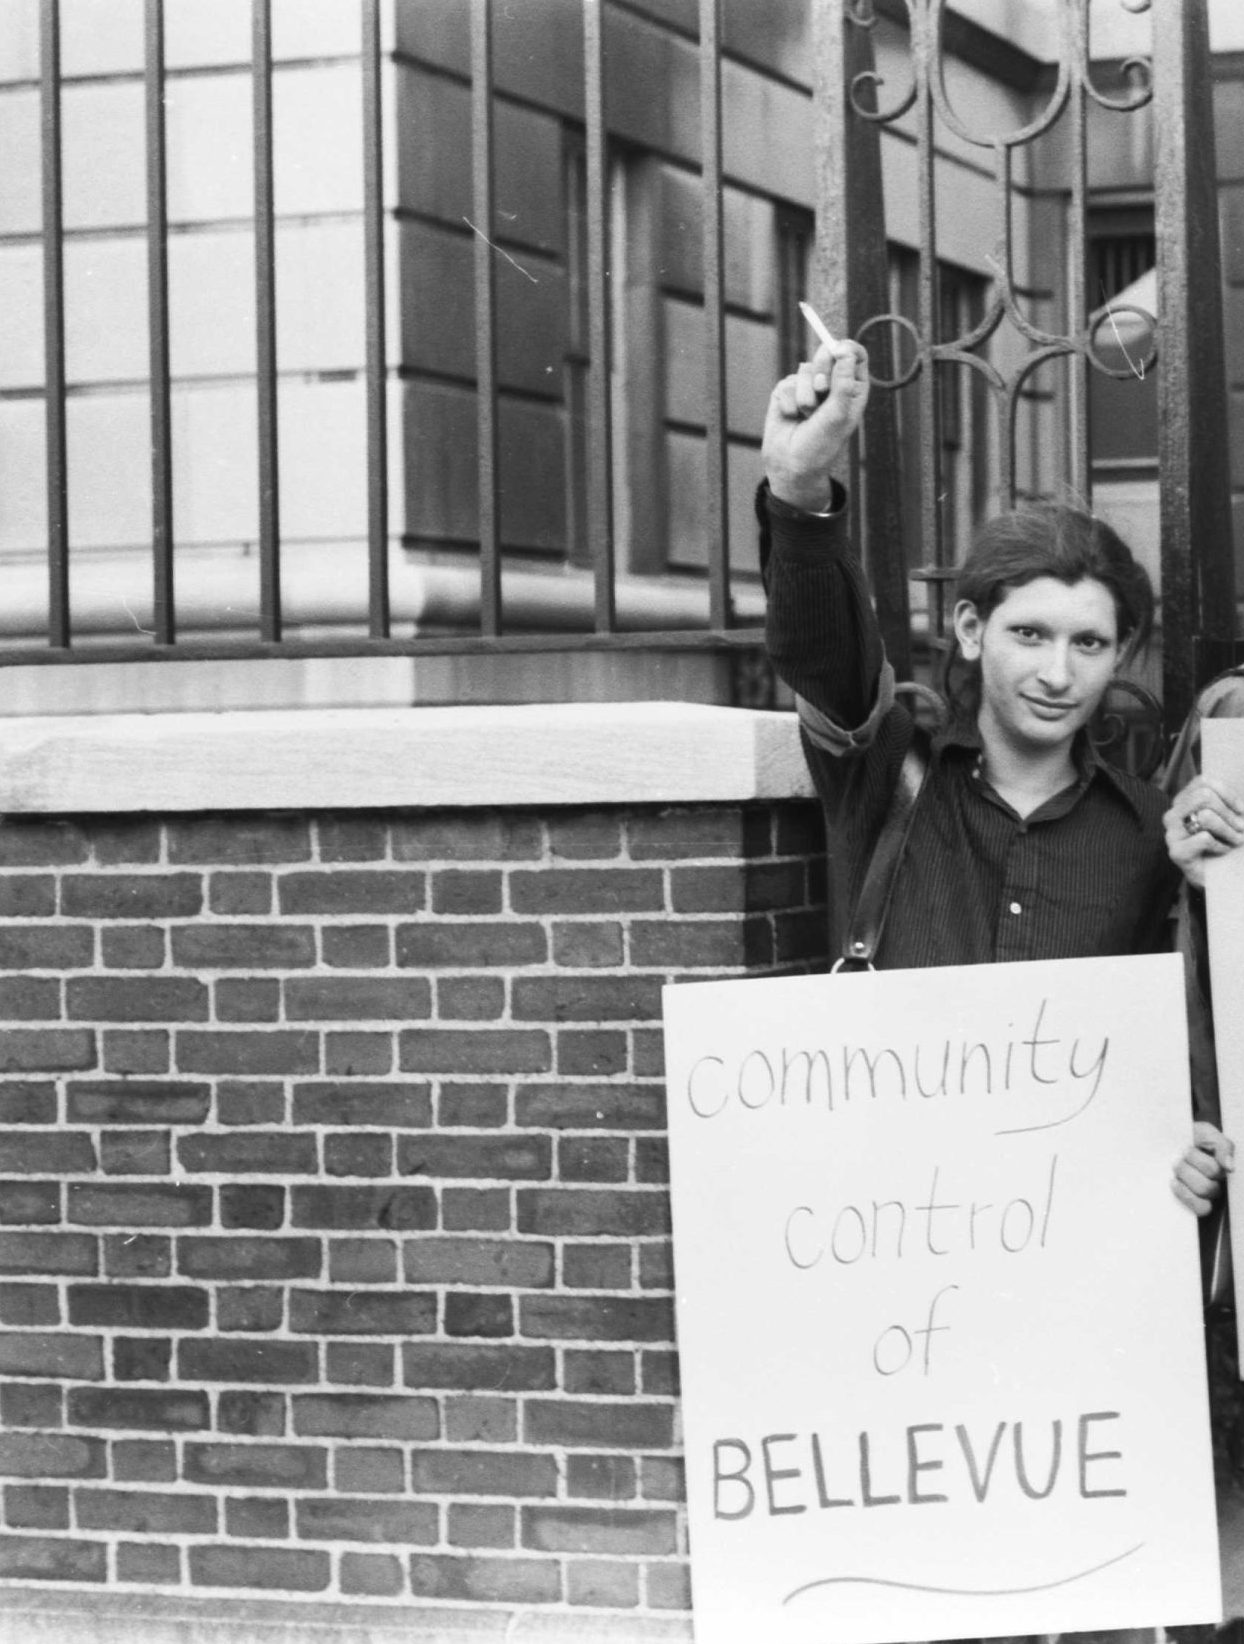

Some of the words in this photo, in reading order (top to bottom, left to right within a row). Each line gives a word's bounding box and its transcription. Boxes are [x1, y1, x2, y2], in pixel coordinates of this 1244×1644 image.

[687, 998, 1109, 1135] community
[785, 1154, 1058, 1268] control
[873, 1284, 960, 1376] of
[712, 1410, 1127, 1520] BELLEVUE
